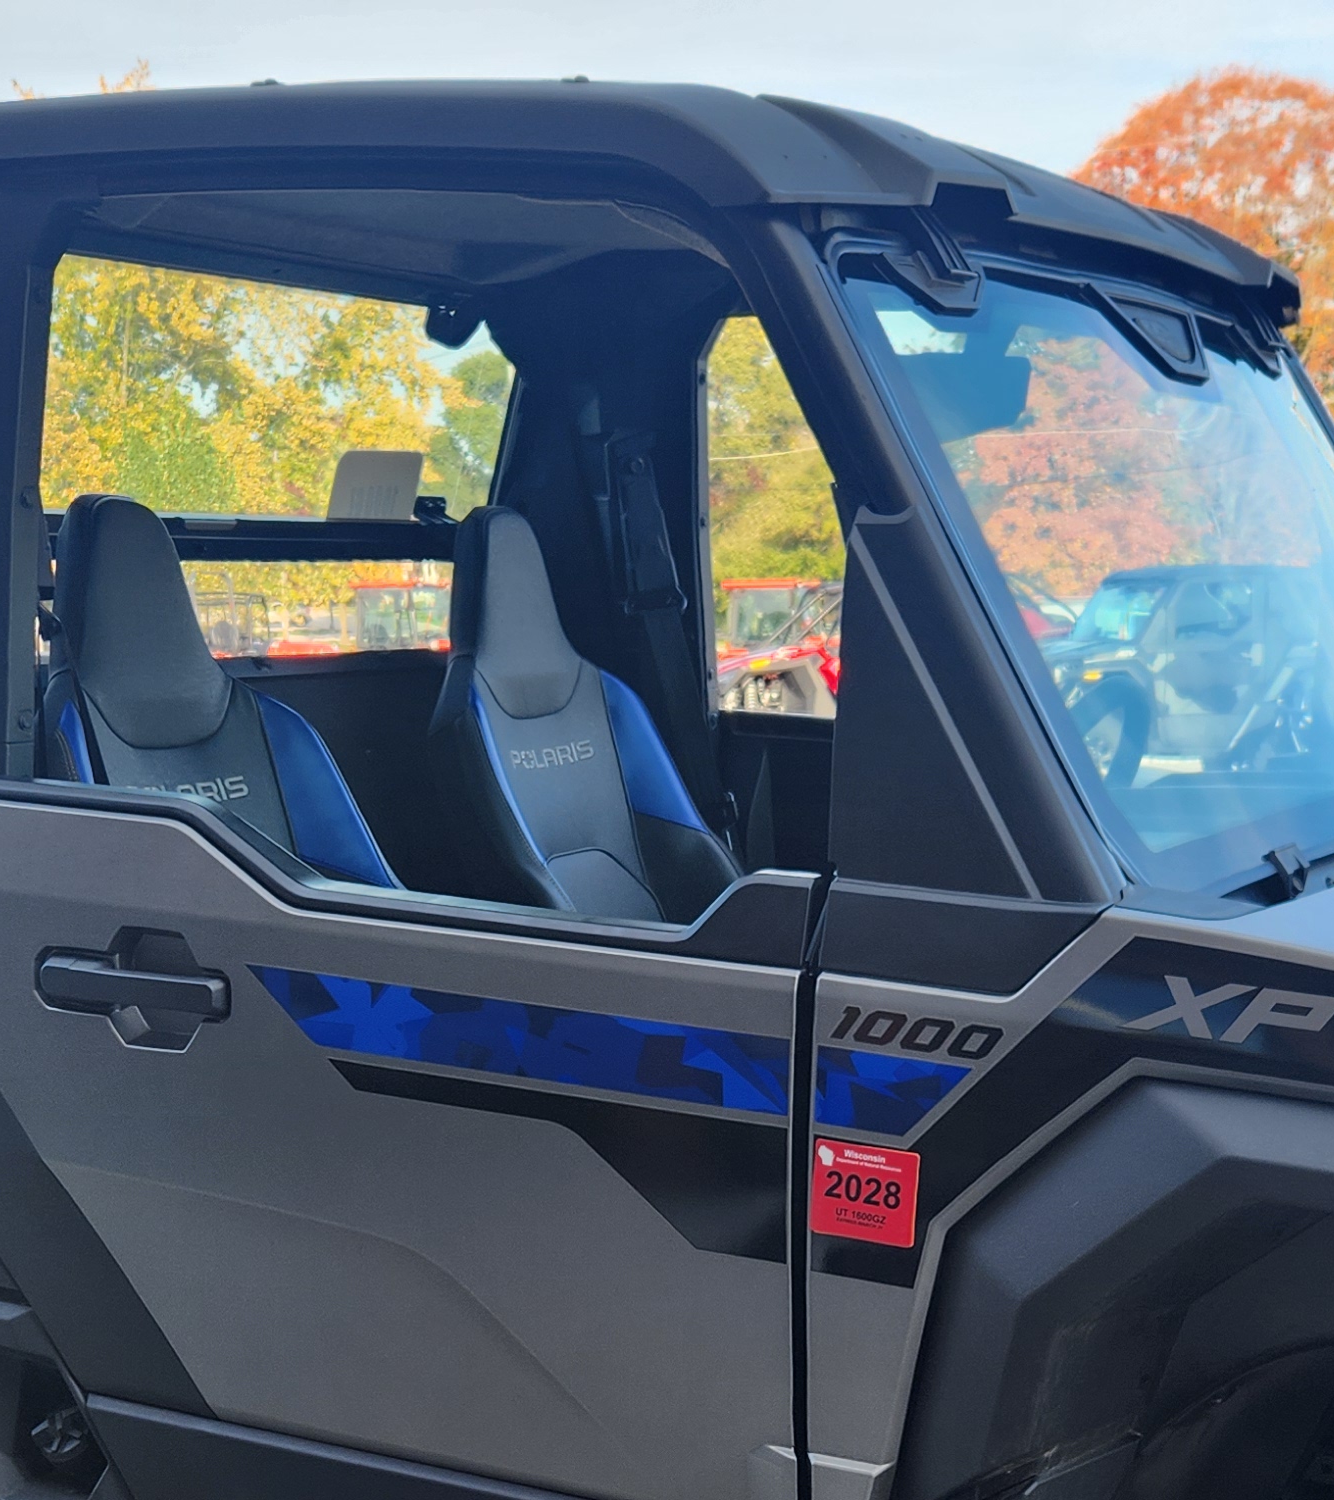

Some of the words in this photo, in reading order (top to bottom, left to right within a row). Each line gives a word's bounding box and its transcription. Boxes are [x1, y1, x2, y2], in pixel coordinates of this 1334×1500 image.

[510, 739, 595, 770] POLARIS
[830, 1004, 1007, 1061] 1000
[843, 1149, 886, 1164] Wisconsin
[824, 1170, 901, 1209] 2028
[835, 1207, 848, 1217] UT
